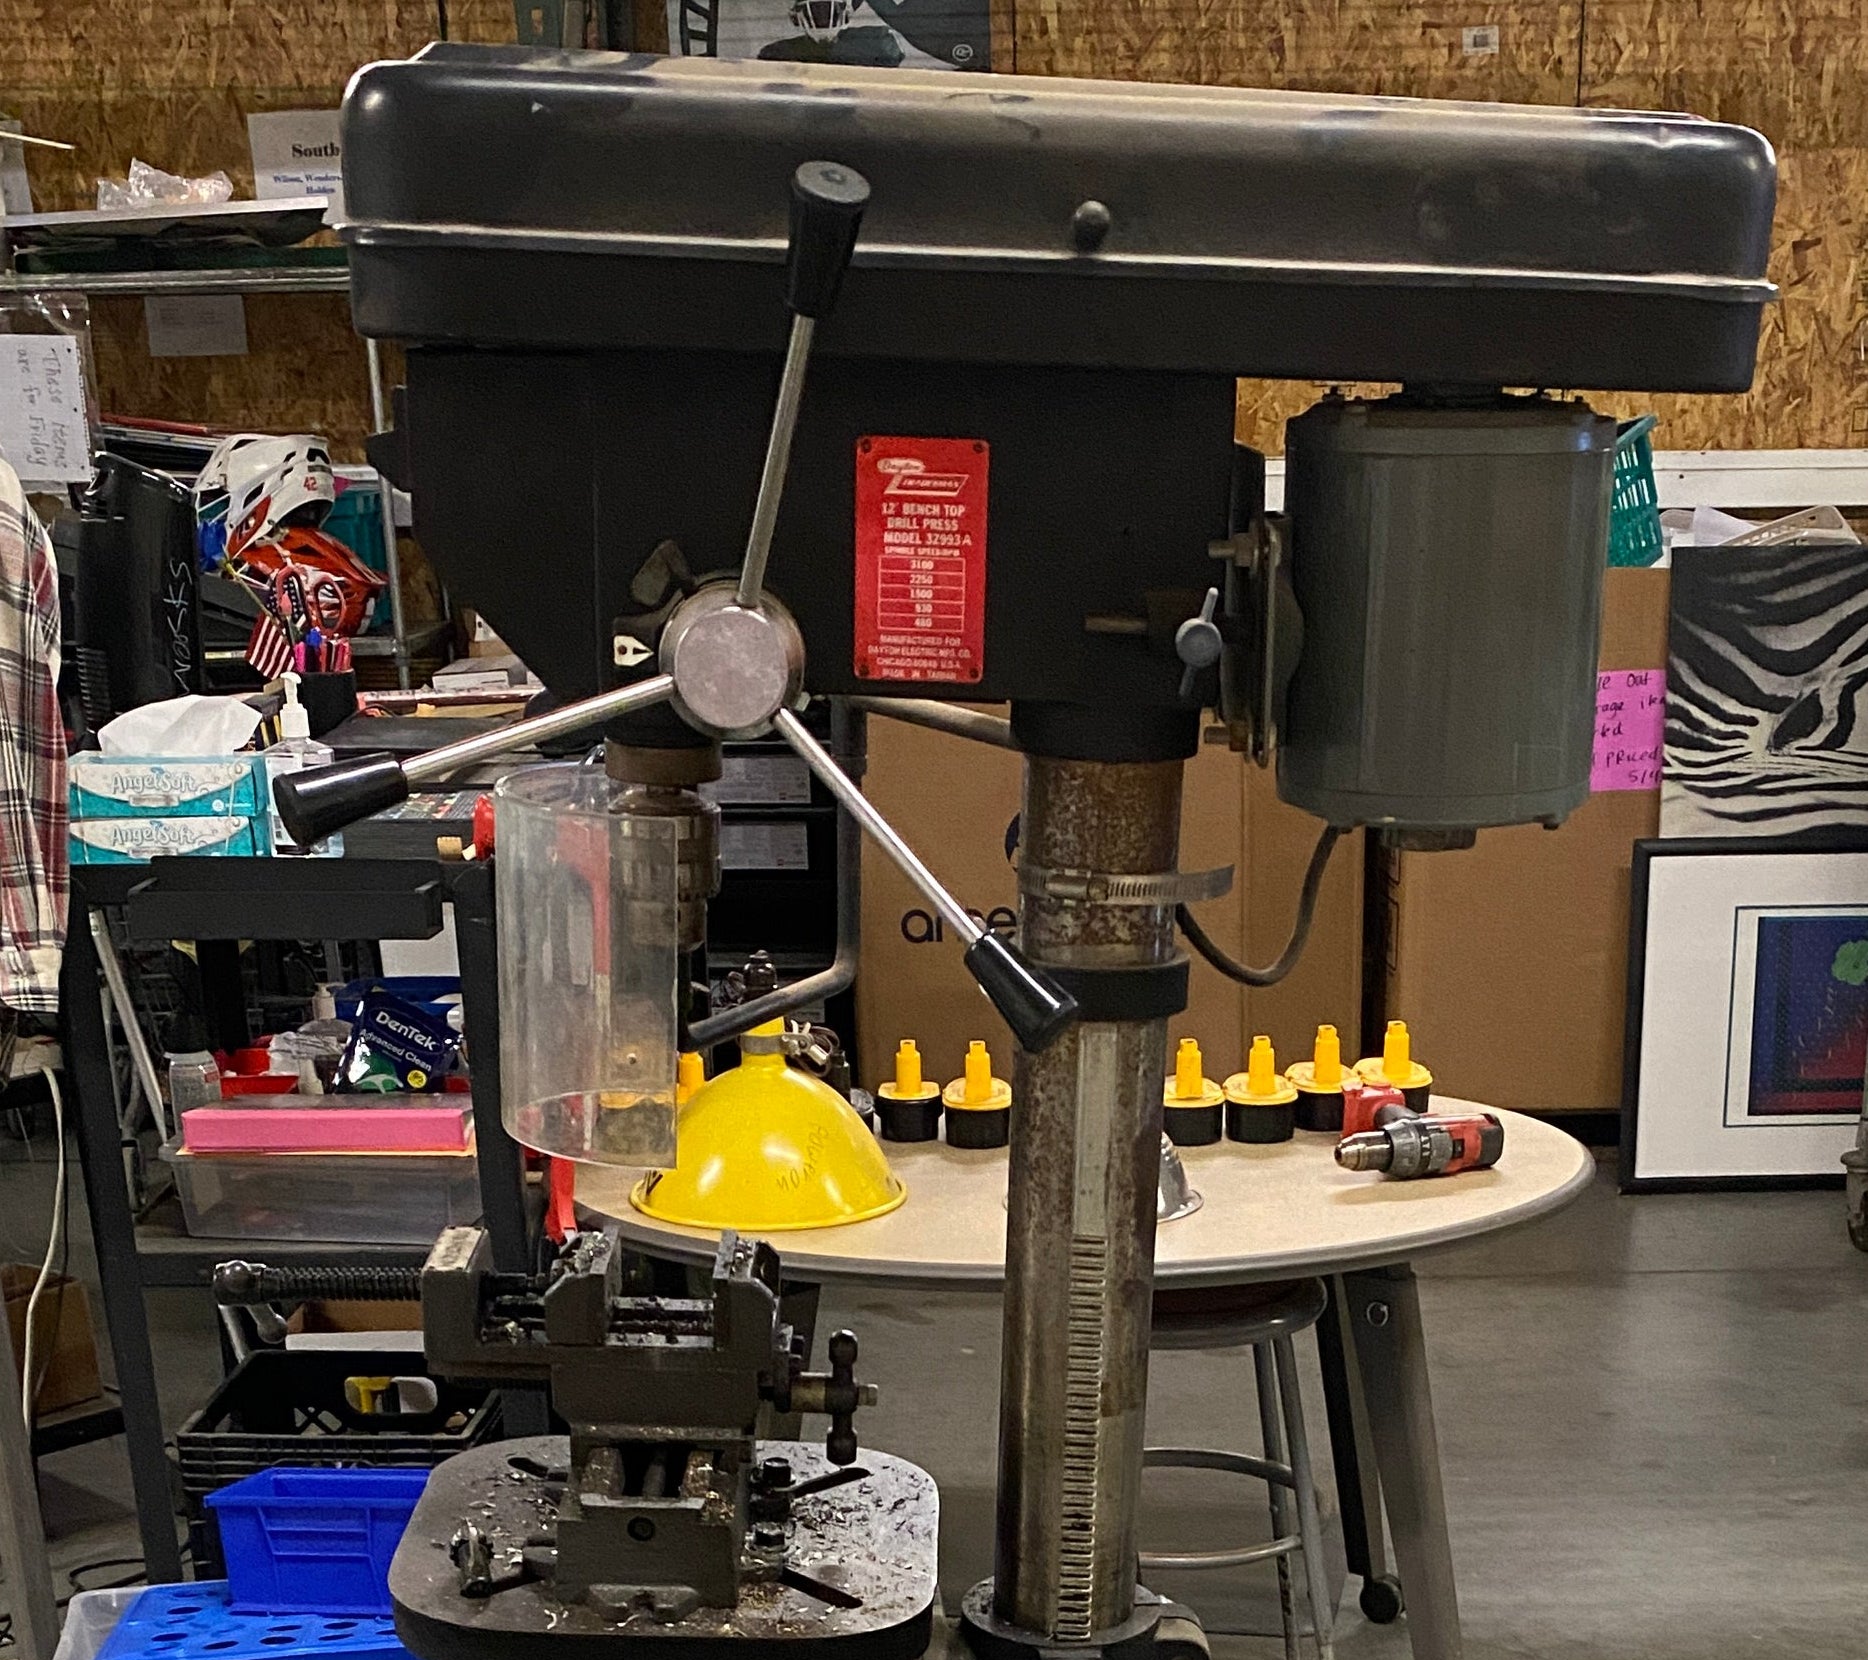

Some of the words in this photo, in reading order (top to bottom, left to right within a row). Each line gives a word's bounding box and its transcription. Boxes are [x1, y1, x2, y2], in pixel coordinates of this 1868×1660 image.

[943, 504, 966, 517] TOP
[887, 516, 920, 530] DRILL
[922, 518, 959, 532] PRESS
[883, 531, 922, 545] MODEL
[375, 1010, 437, 1052] DenTek
[404, 1050, 433, 1073] Clean
